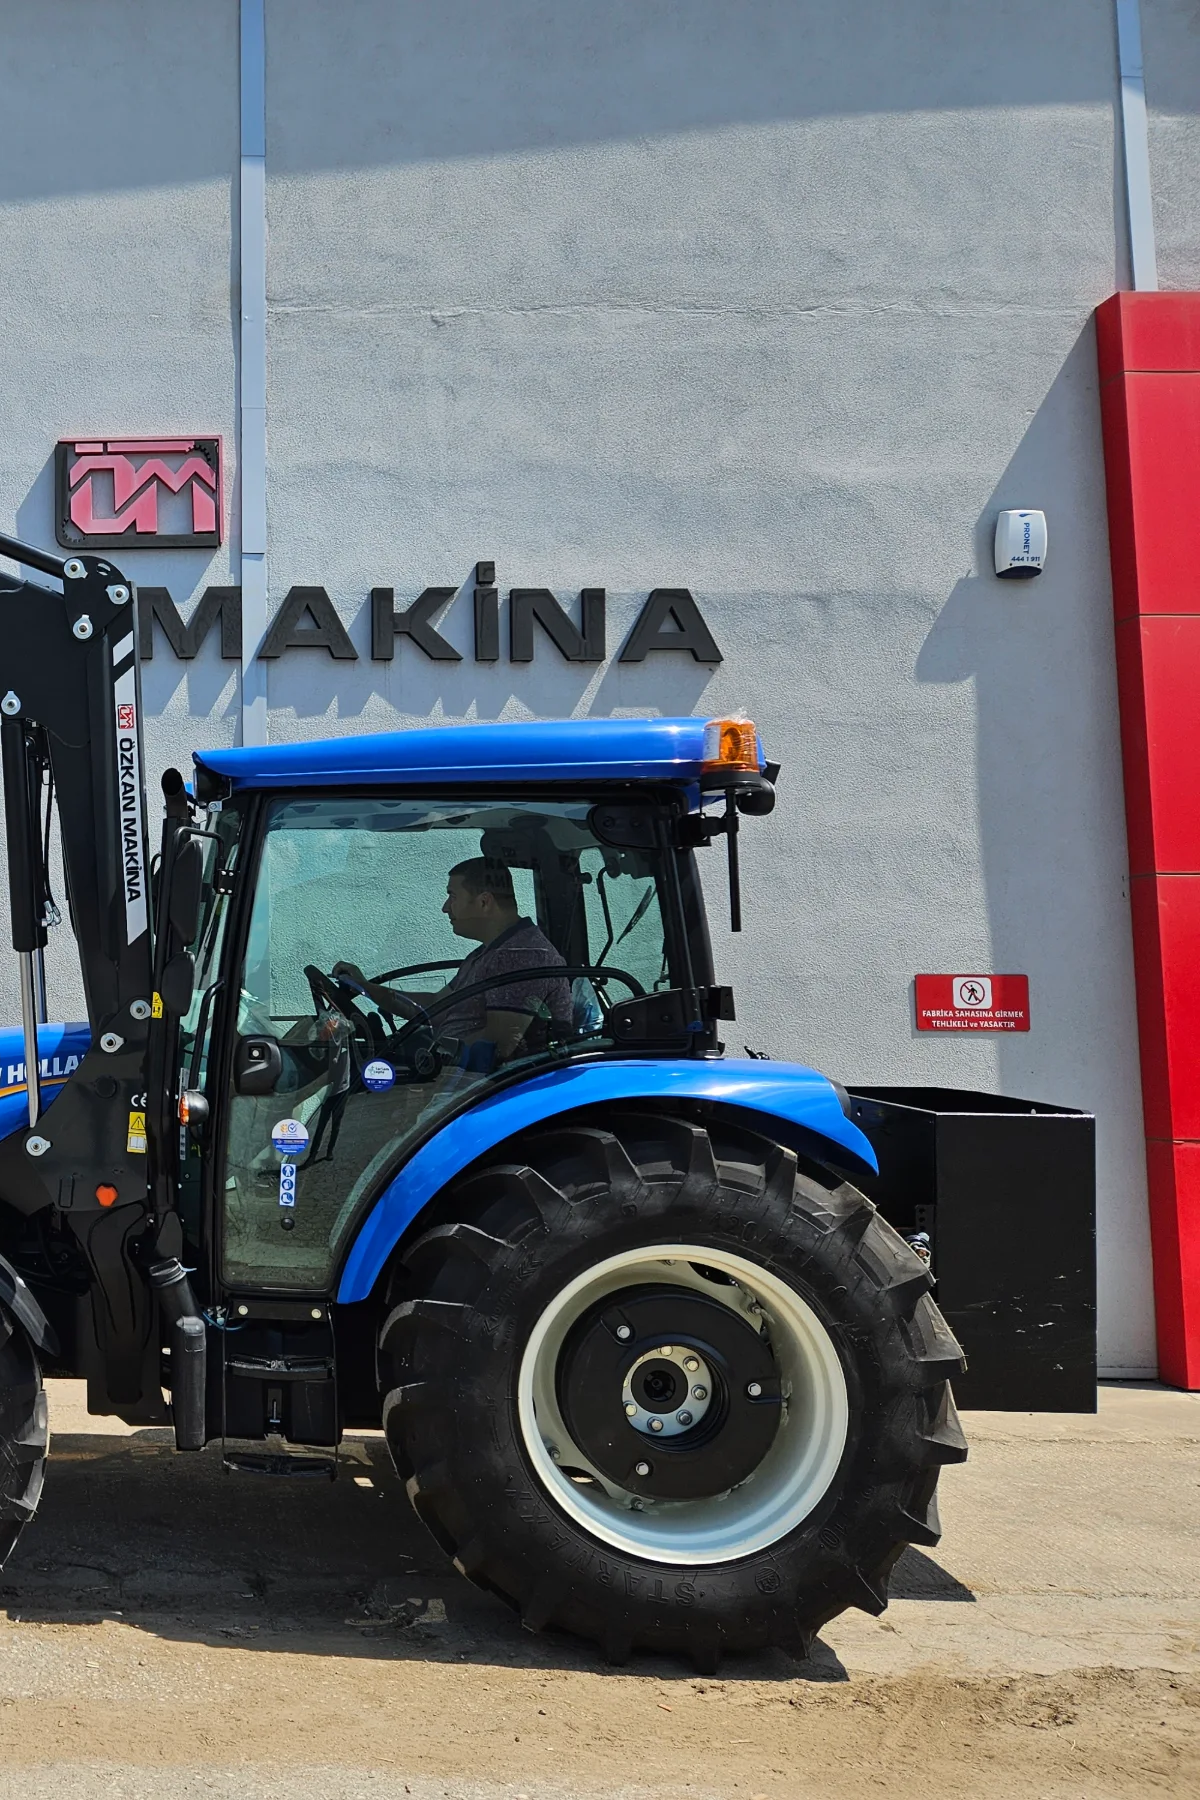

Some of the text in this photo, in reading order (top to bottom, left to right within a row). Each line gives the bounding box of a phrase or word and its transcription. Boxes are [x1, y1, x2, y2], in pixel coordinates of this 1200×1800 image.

[1023, 523, 1031, 554] PRONET
[137, 560, 724, 663] MAKİNA
[119, 737, 142, 903] ÖZKAN MAKİNA
[922, 1008, 1024, 1018] FABRİKA SAHASINA GİRMEK
[932, 1018, 968, 1028] TEHLİKELİ
[979, 1020, 1015, 1028] YASAKTIR
[504, 1487, 697, 1607] STARMAXX
